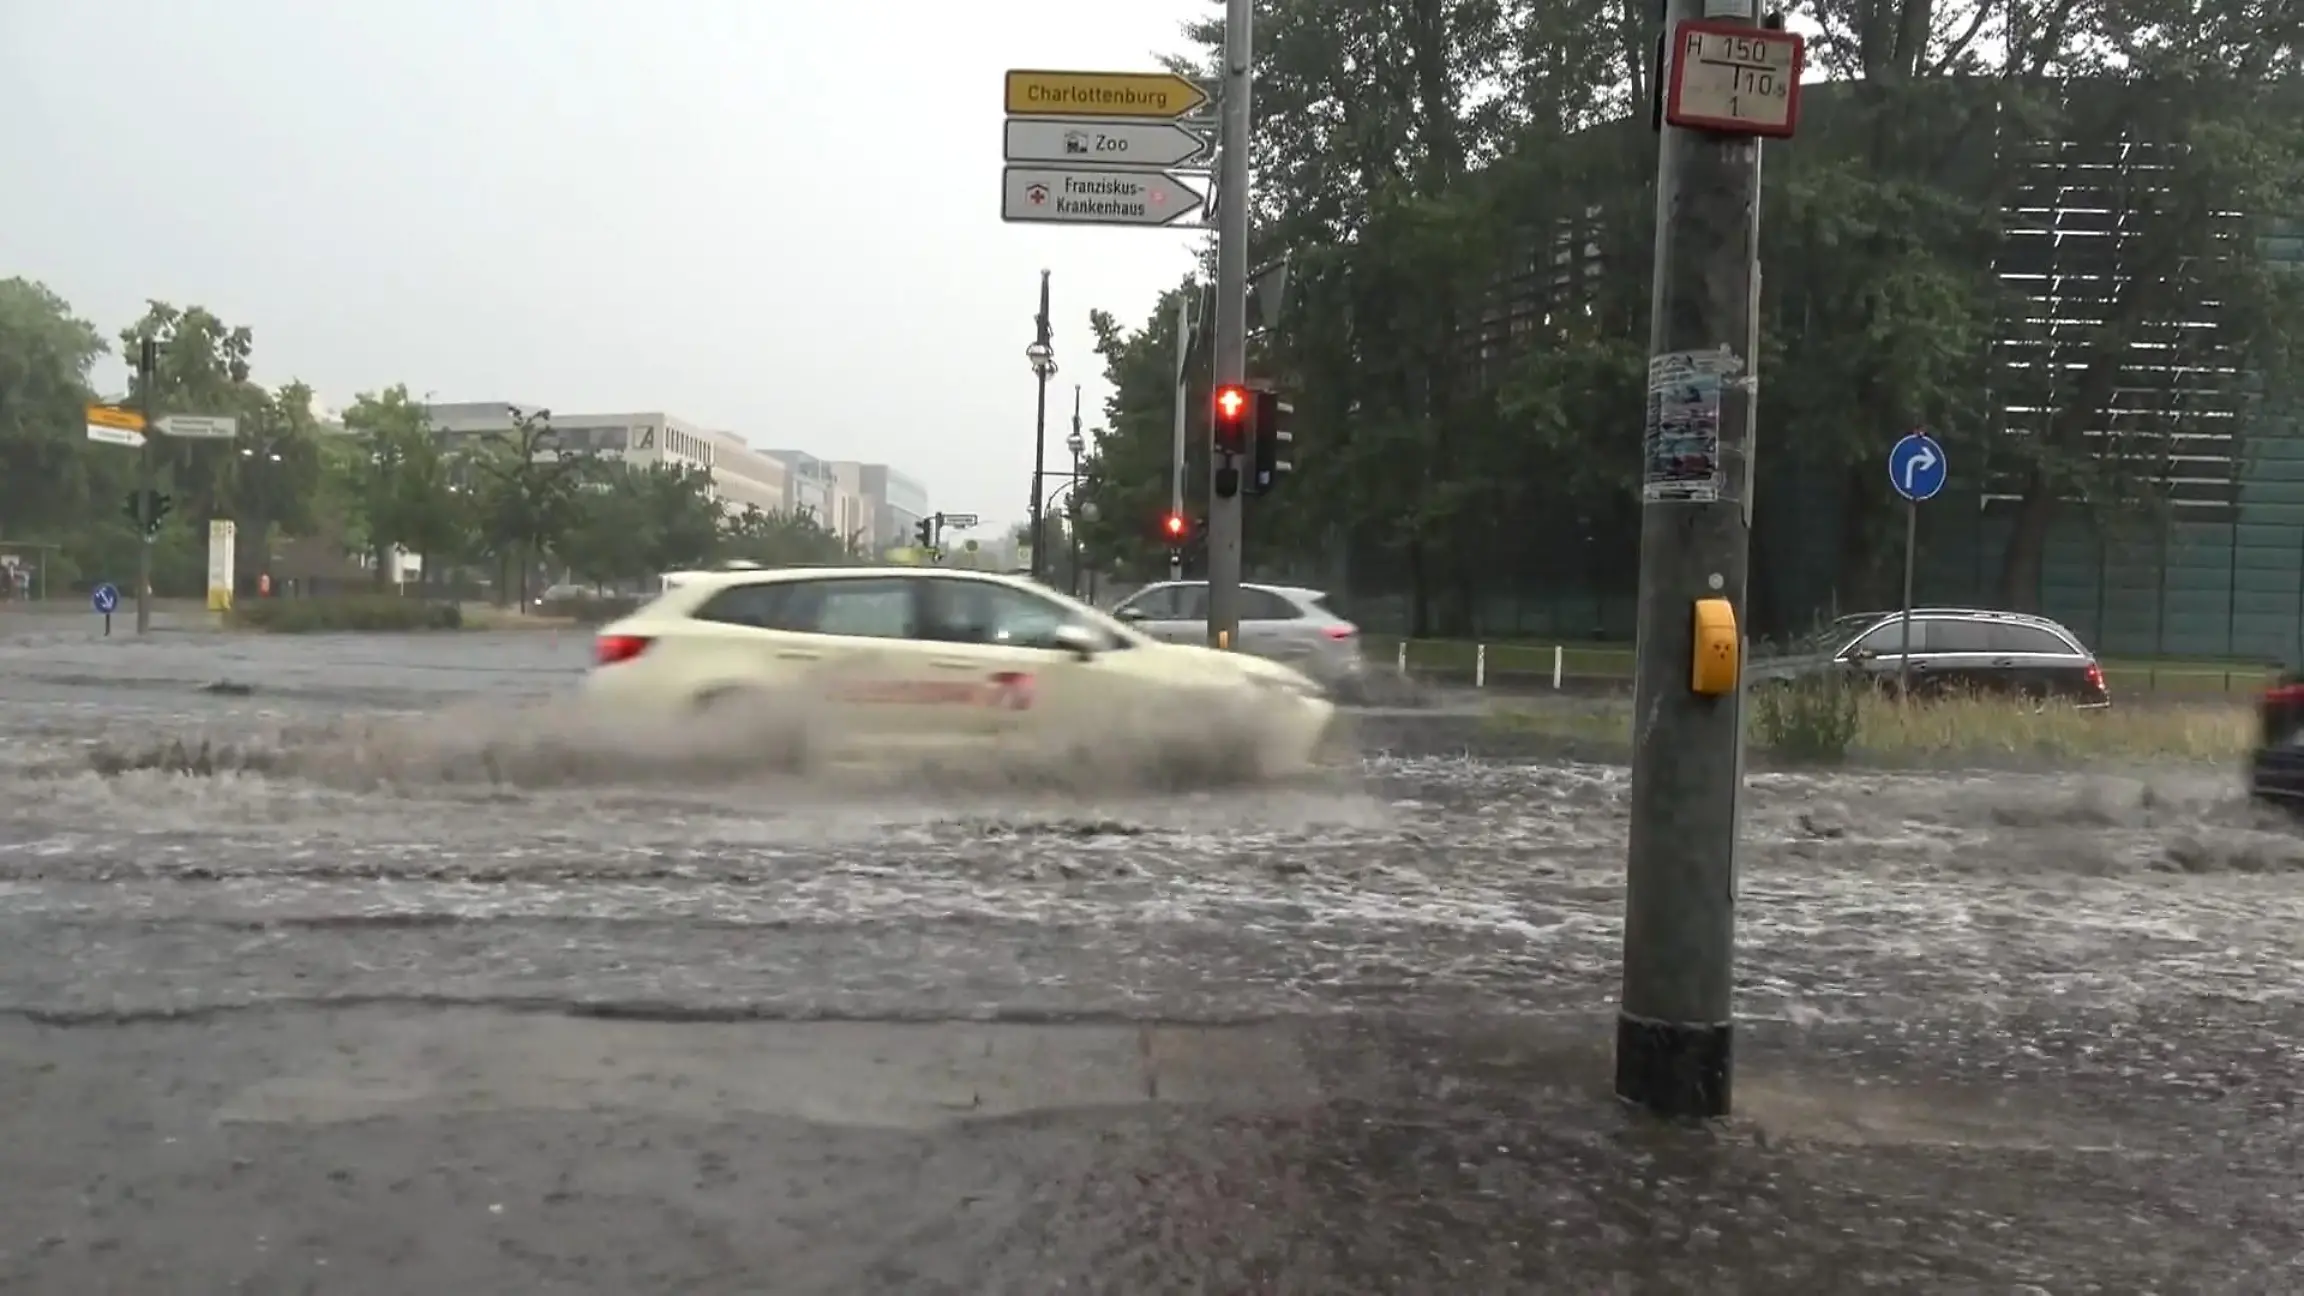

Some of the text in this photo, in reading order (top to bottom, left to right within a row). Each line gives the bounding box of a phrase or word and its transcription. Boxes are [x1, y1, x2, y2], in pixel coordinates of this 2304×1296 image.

[1687, 34, 1766, 62] H 150
[1028, 85, 1167, 108] Charlottenburg
[1096, 134, 1128, 151] Zoo
[1065, 177, 1145, 196] Franziskus-
[1057, 197, 1145, 216] Krankenhaus
